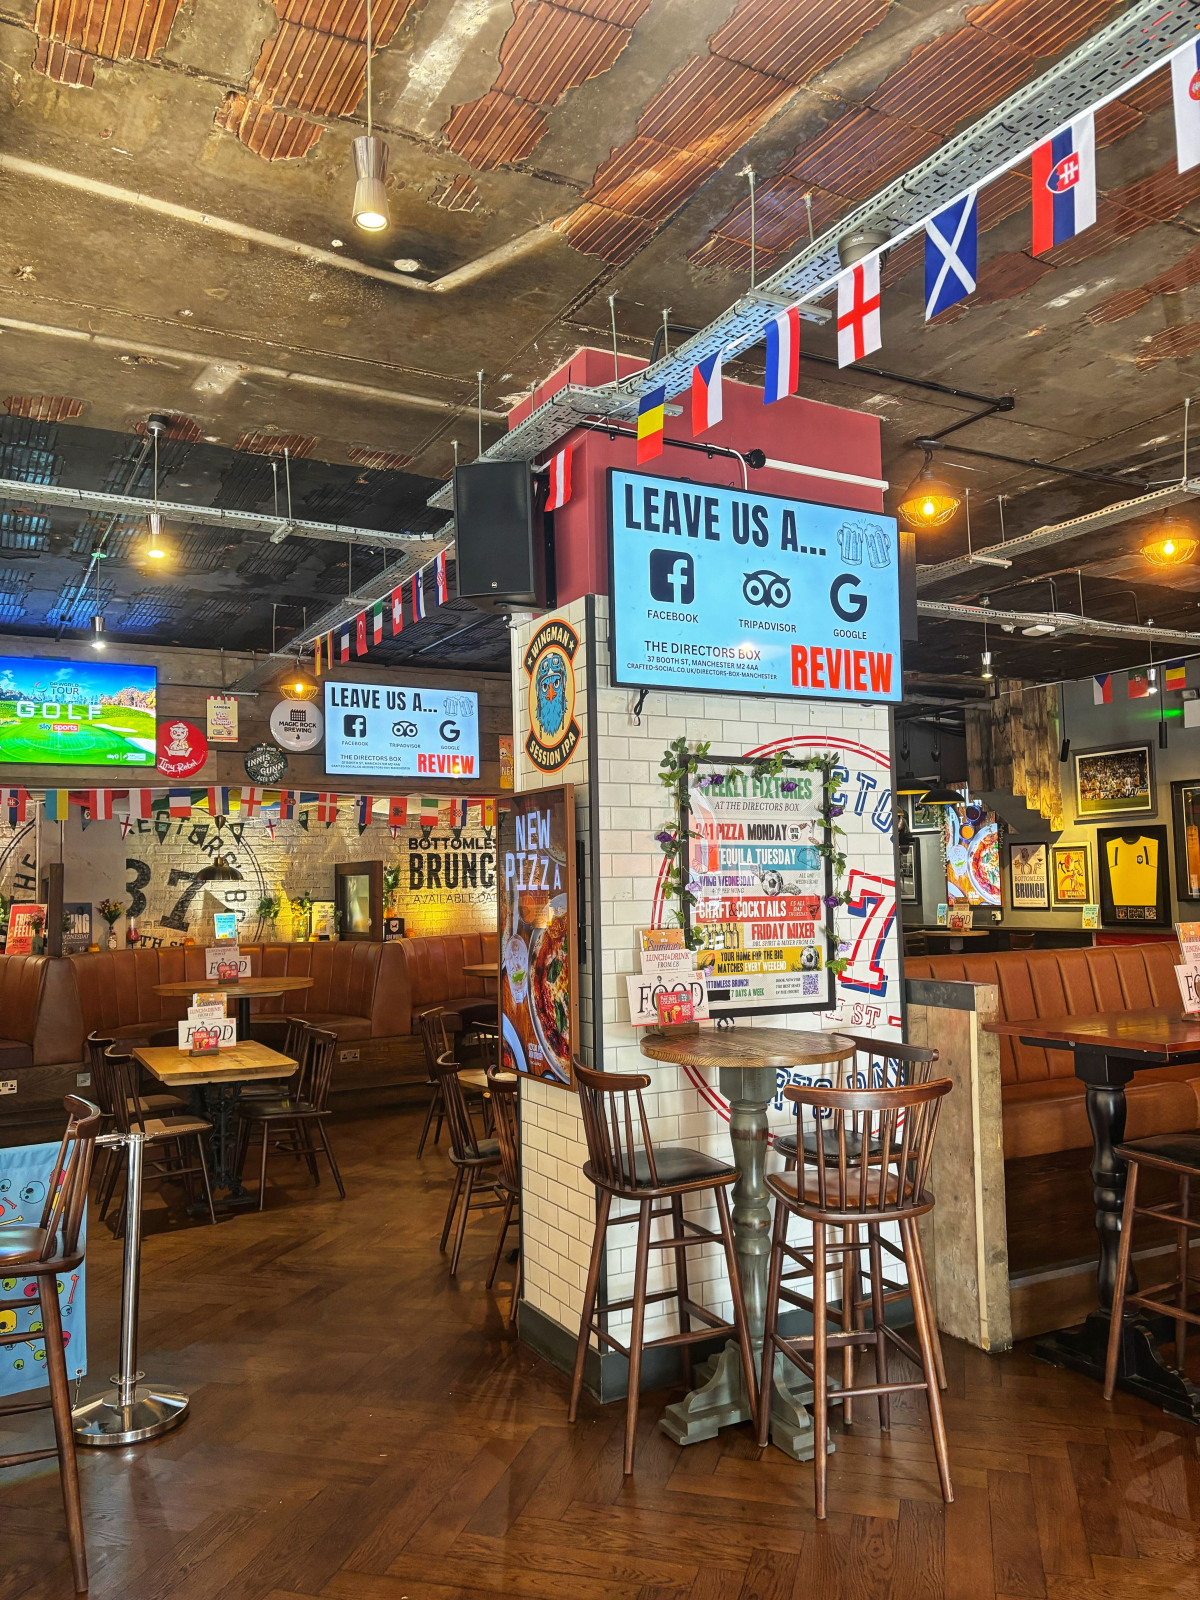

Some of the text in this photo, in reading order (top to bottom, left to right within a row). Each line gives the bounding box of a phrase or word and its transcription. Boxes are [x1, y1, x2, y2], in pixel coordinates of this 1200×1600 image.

[624, 483, 827, 556] LEAVE US A...
[647, 609, 699, 624] FACEBOOK
[738, 618, 797, 634] TRIPADVISOR
[833, 628, 867, 640] GOOGLE
[530, 626, 570, 659] WINGMAN
[644, 640, 761, 661] THE DIRECTORS BOX
[647, 655, 759, 671] 37 BOOTH ST, MANCHESTER M2 4AA
[790, 644, 893, 694] REVIEW
[51, 687, 80, 695] TOUR
[331, 686, 438, 713] LEAVE US A...
[16, 700, 103, 721] GOLF
[38, 722, 78, 732] sky sports
[529, 731, 576, 766] SESSION IPA
[176, 758, 197, 772] Rebel
[247, 754, 271, 768] INNIS
[260, 761, 284, 774] GUNN
[263, 760, 270, 768] &
[417, 753, 475, 775] REVIEW
[714, 801, 800, 812] AT THE DIRECTORS BOX
[515, 809, 551, 851] NEW
[696, 822, 788, 841] 241 PIZZA MONDAY
[718, 847, 797, 867] EQUILA TUESDAY
[505, 852, 562, 891] PIZZA
[718, 875, 755, 887] WEDNESDAY
[1014, 883, 1046, 899] BRUNCH
[729, 902, 738, 917] &
[736, 900, 787, 919] COCKTAILS
[751, 922, 816, 940] FRIDAY MIXER
[646, 953, 668, 962] LUNCH
[670, 952, 690, 960] DRINK
[720, 949, 784, 962] YOUR HOME FOR THE BIG
[717, 960, 787, 974] MATCHES EVERY WEEKEND
[731, 978, 749, 988] BRUNCH
[731, 989, 735, 998] 7
[735, 989, 747, 998] DAYS
[753, 988, 765, 997] WEEK
